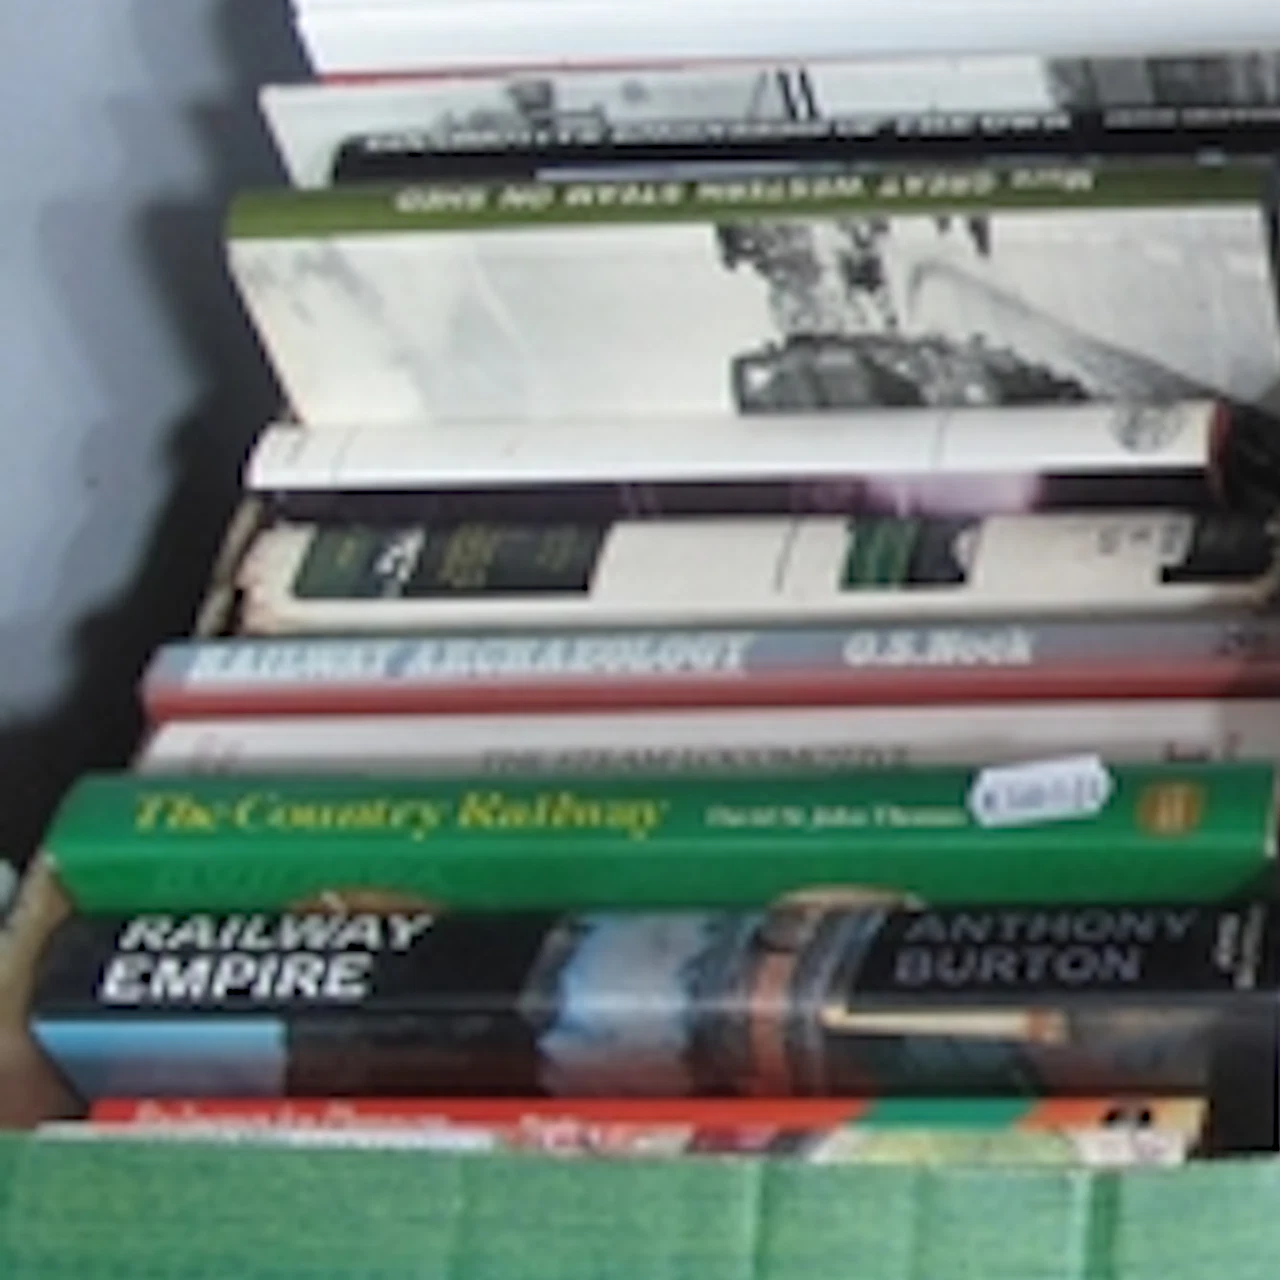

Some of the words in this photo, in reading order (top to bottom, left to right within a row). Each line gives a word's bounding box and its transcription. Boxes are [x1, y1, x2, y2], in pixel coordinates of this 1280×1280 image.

[499, 183, 552, 213] ON
[564, 177, 683, 209] STEAM
[699, 171, 863, 202] WESTERN
[876, 167, 999, 199] GREAT
[394, 187, 488, 216] SHED
[188, 636, 402, 683] RAILWAY
[402, 630, 754, 678] ARCHAEOLOGY
[133, 792, 220, 834] The
[232, 796, 450, 843] Country
[456, 790, 669, 843] Railway
[118, 912, 436, 952] RAILWAY
[902, 910, 1199, 944] ANTHONY
[102, 953, 376, 1002] EMPIRE
[894, 946, 1142, 983] BURTON
